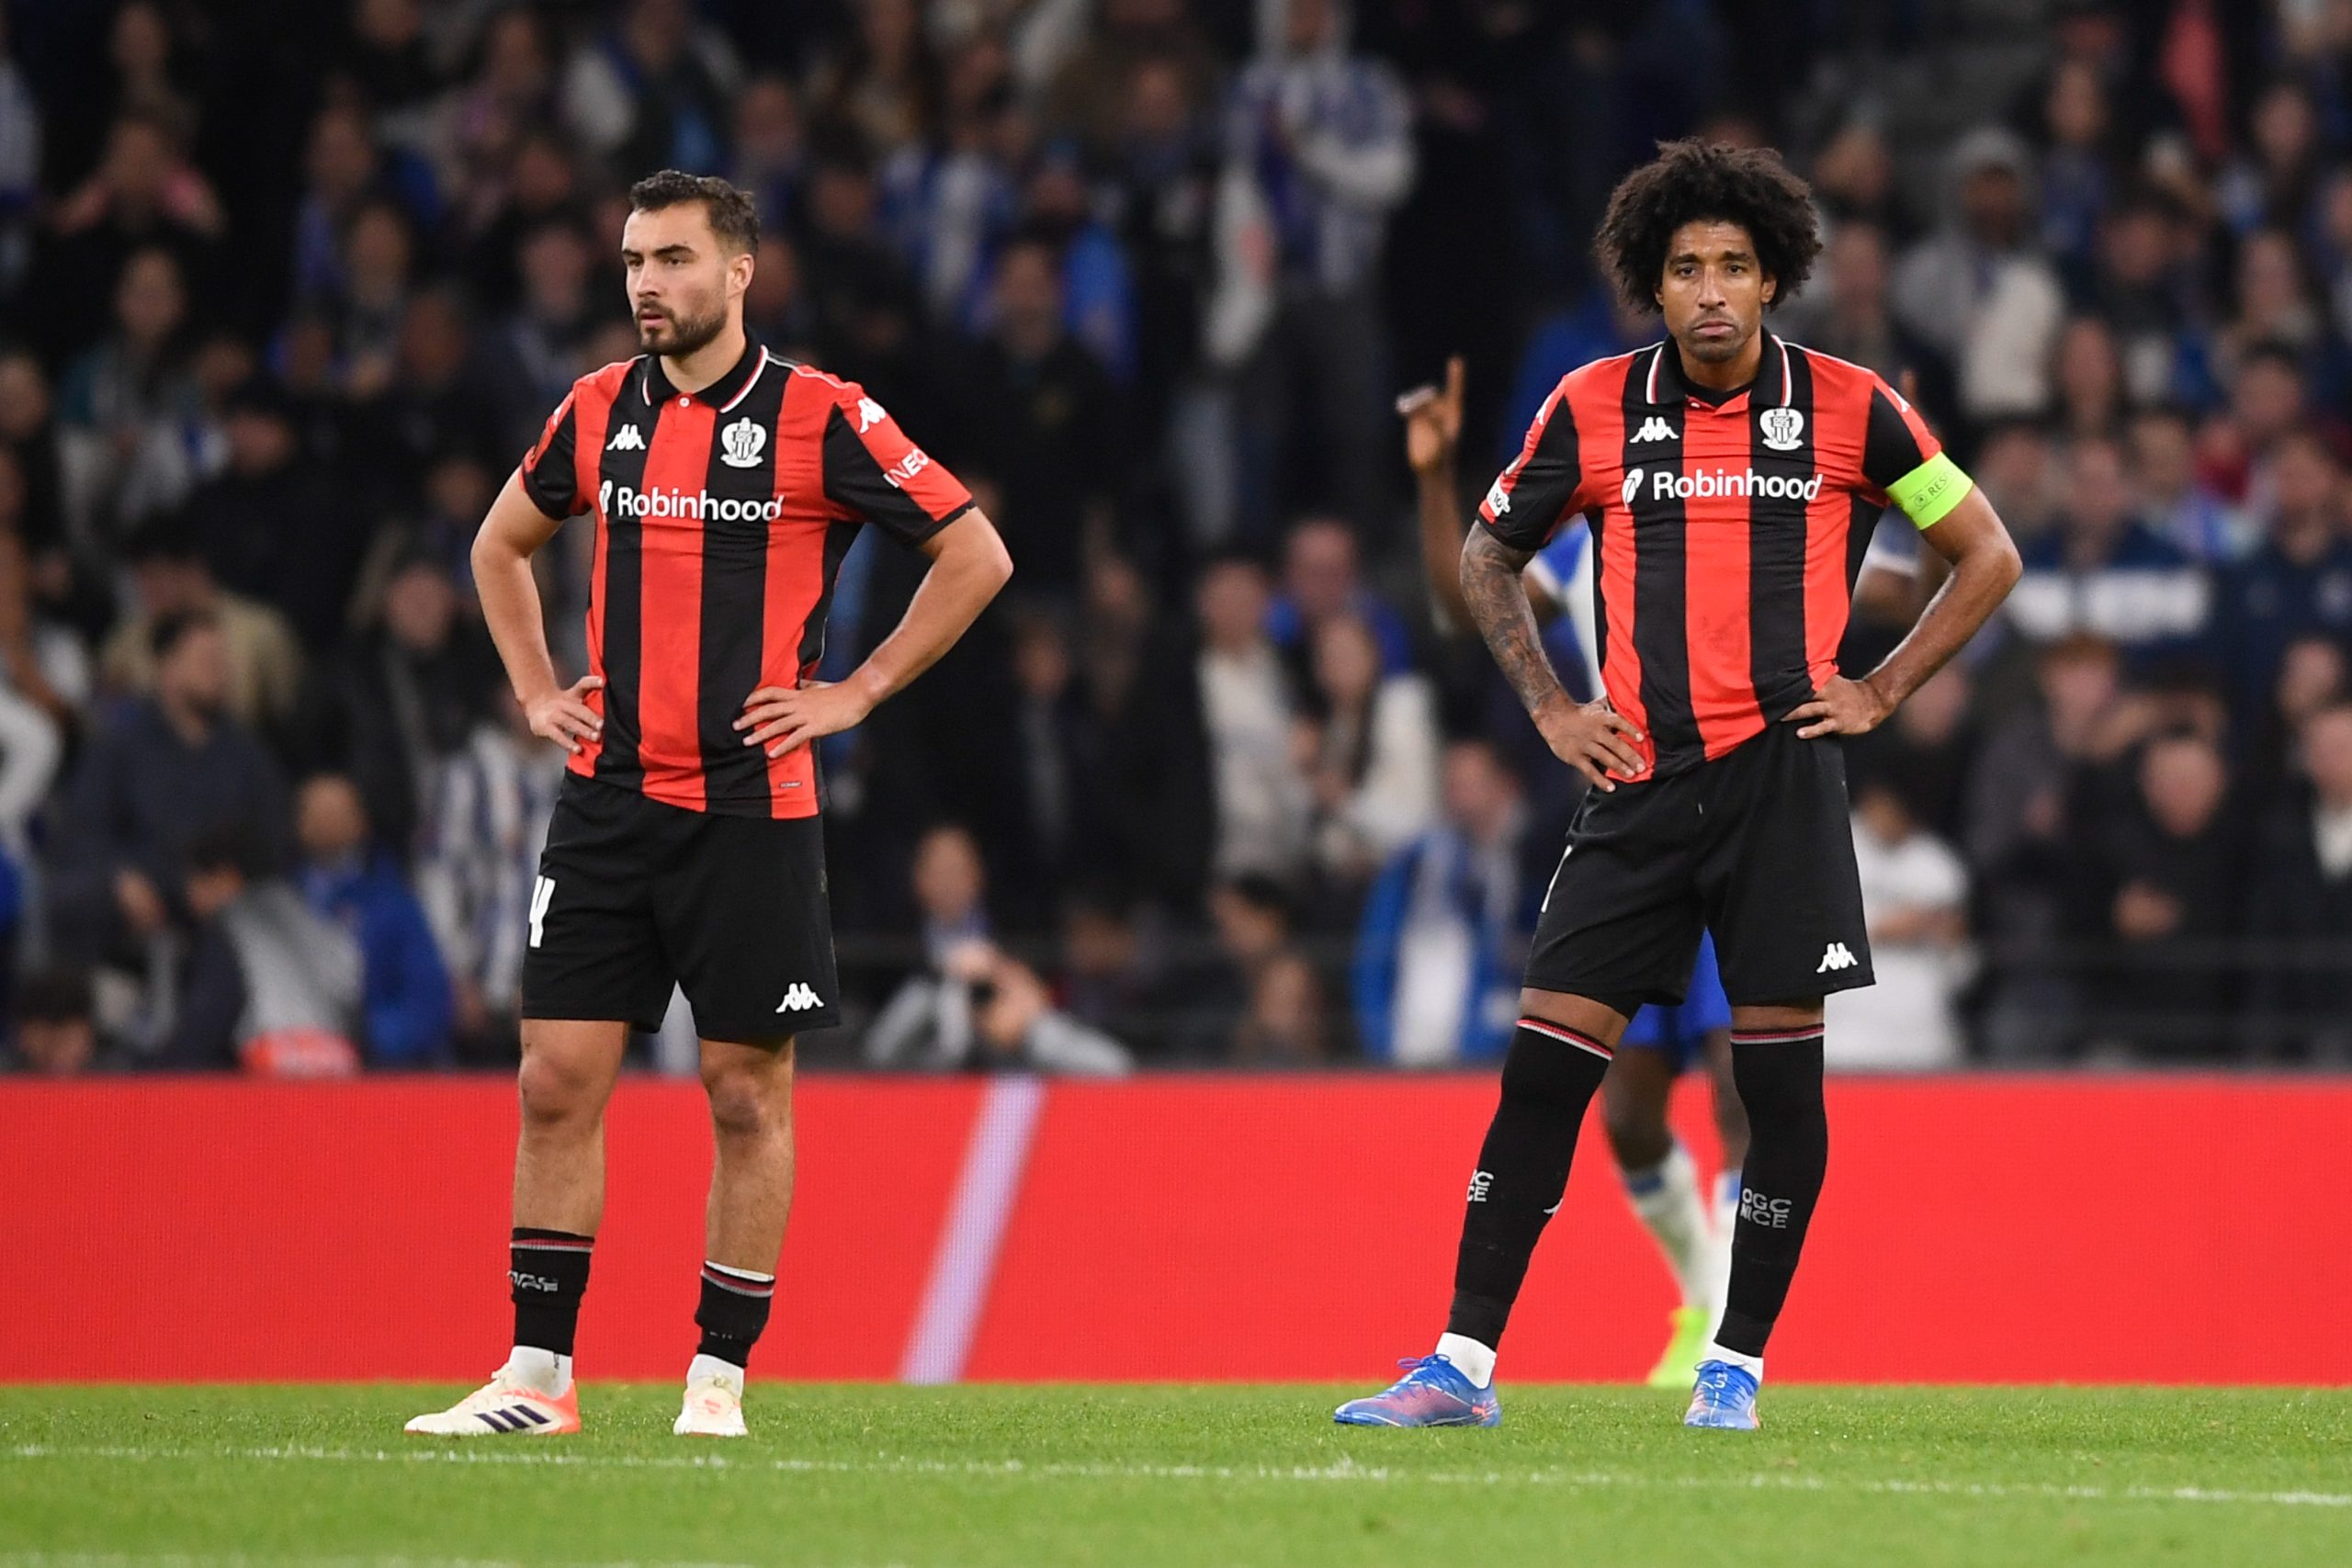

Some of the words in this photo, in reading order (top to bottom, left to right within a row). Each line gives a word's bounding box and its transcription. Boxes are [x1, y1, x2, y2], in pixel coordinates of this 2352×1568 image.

[883, 448, 929, 488] INEO
[1653, 468, 1824, 502] Robinhood
[617, 486, 785, 522] Robinhood
[1740, 1202, 1789, 1229] NICE
[1742, 1188, 1792, 1213] OGC
